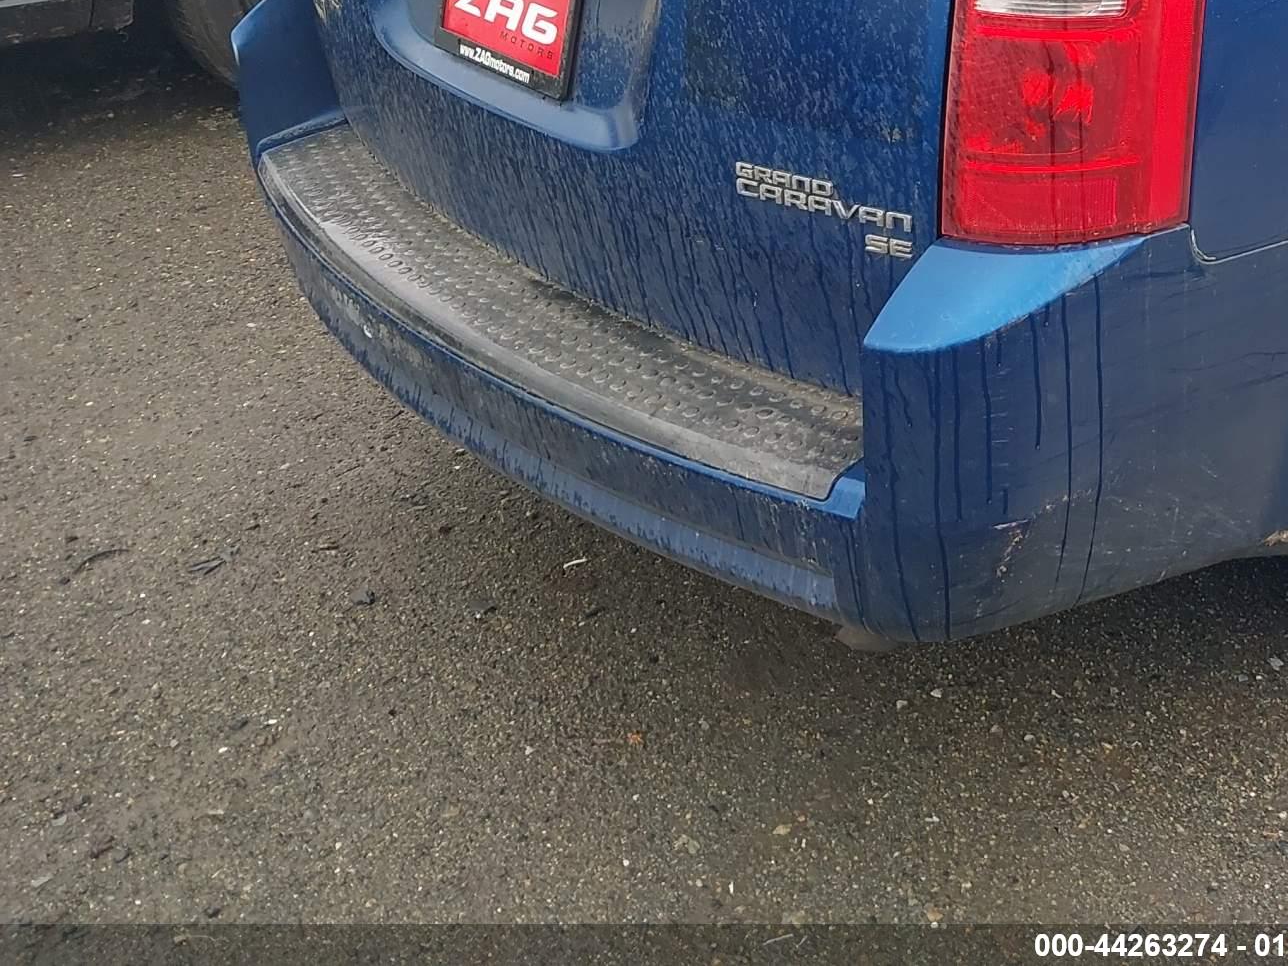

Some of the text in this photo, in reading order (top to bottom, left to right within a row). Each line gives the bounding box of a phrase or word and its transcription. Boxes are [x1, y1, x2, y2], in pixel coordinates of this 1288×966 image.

[500, 31, 555, 60] MOTORS
[735, 160, 834, 196] GRAND
[735, 177, 913, 233] CARAVAN
[864, 233, 913, 260] SE
